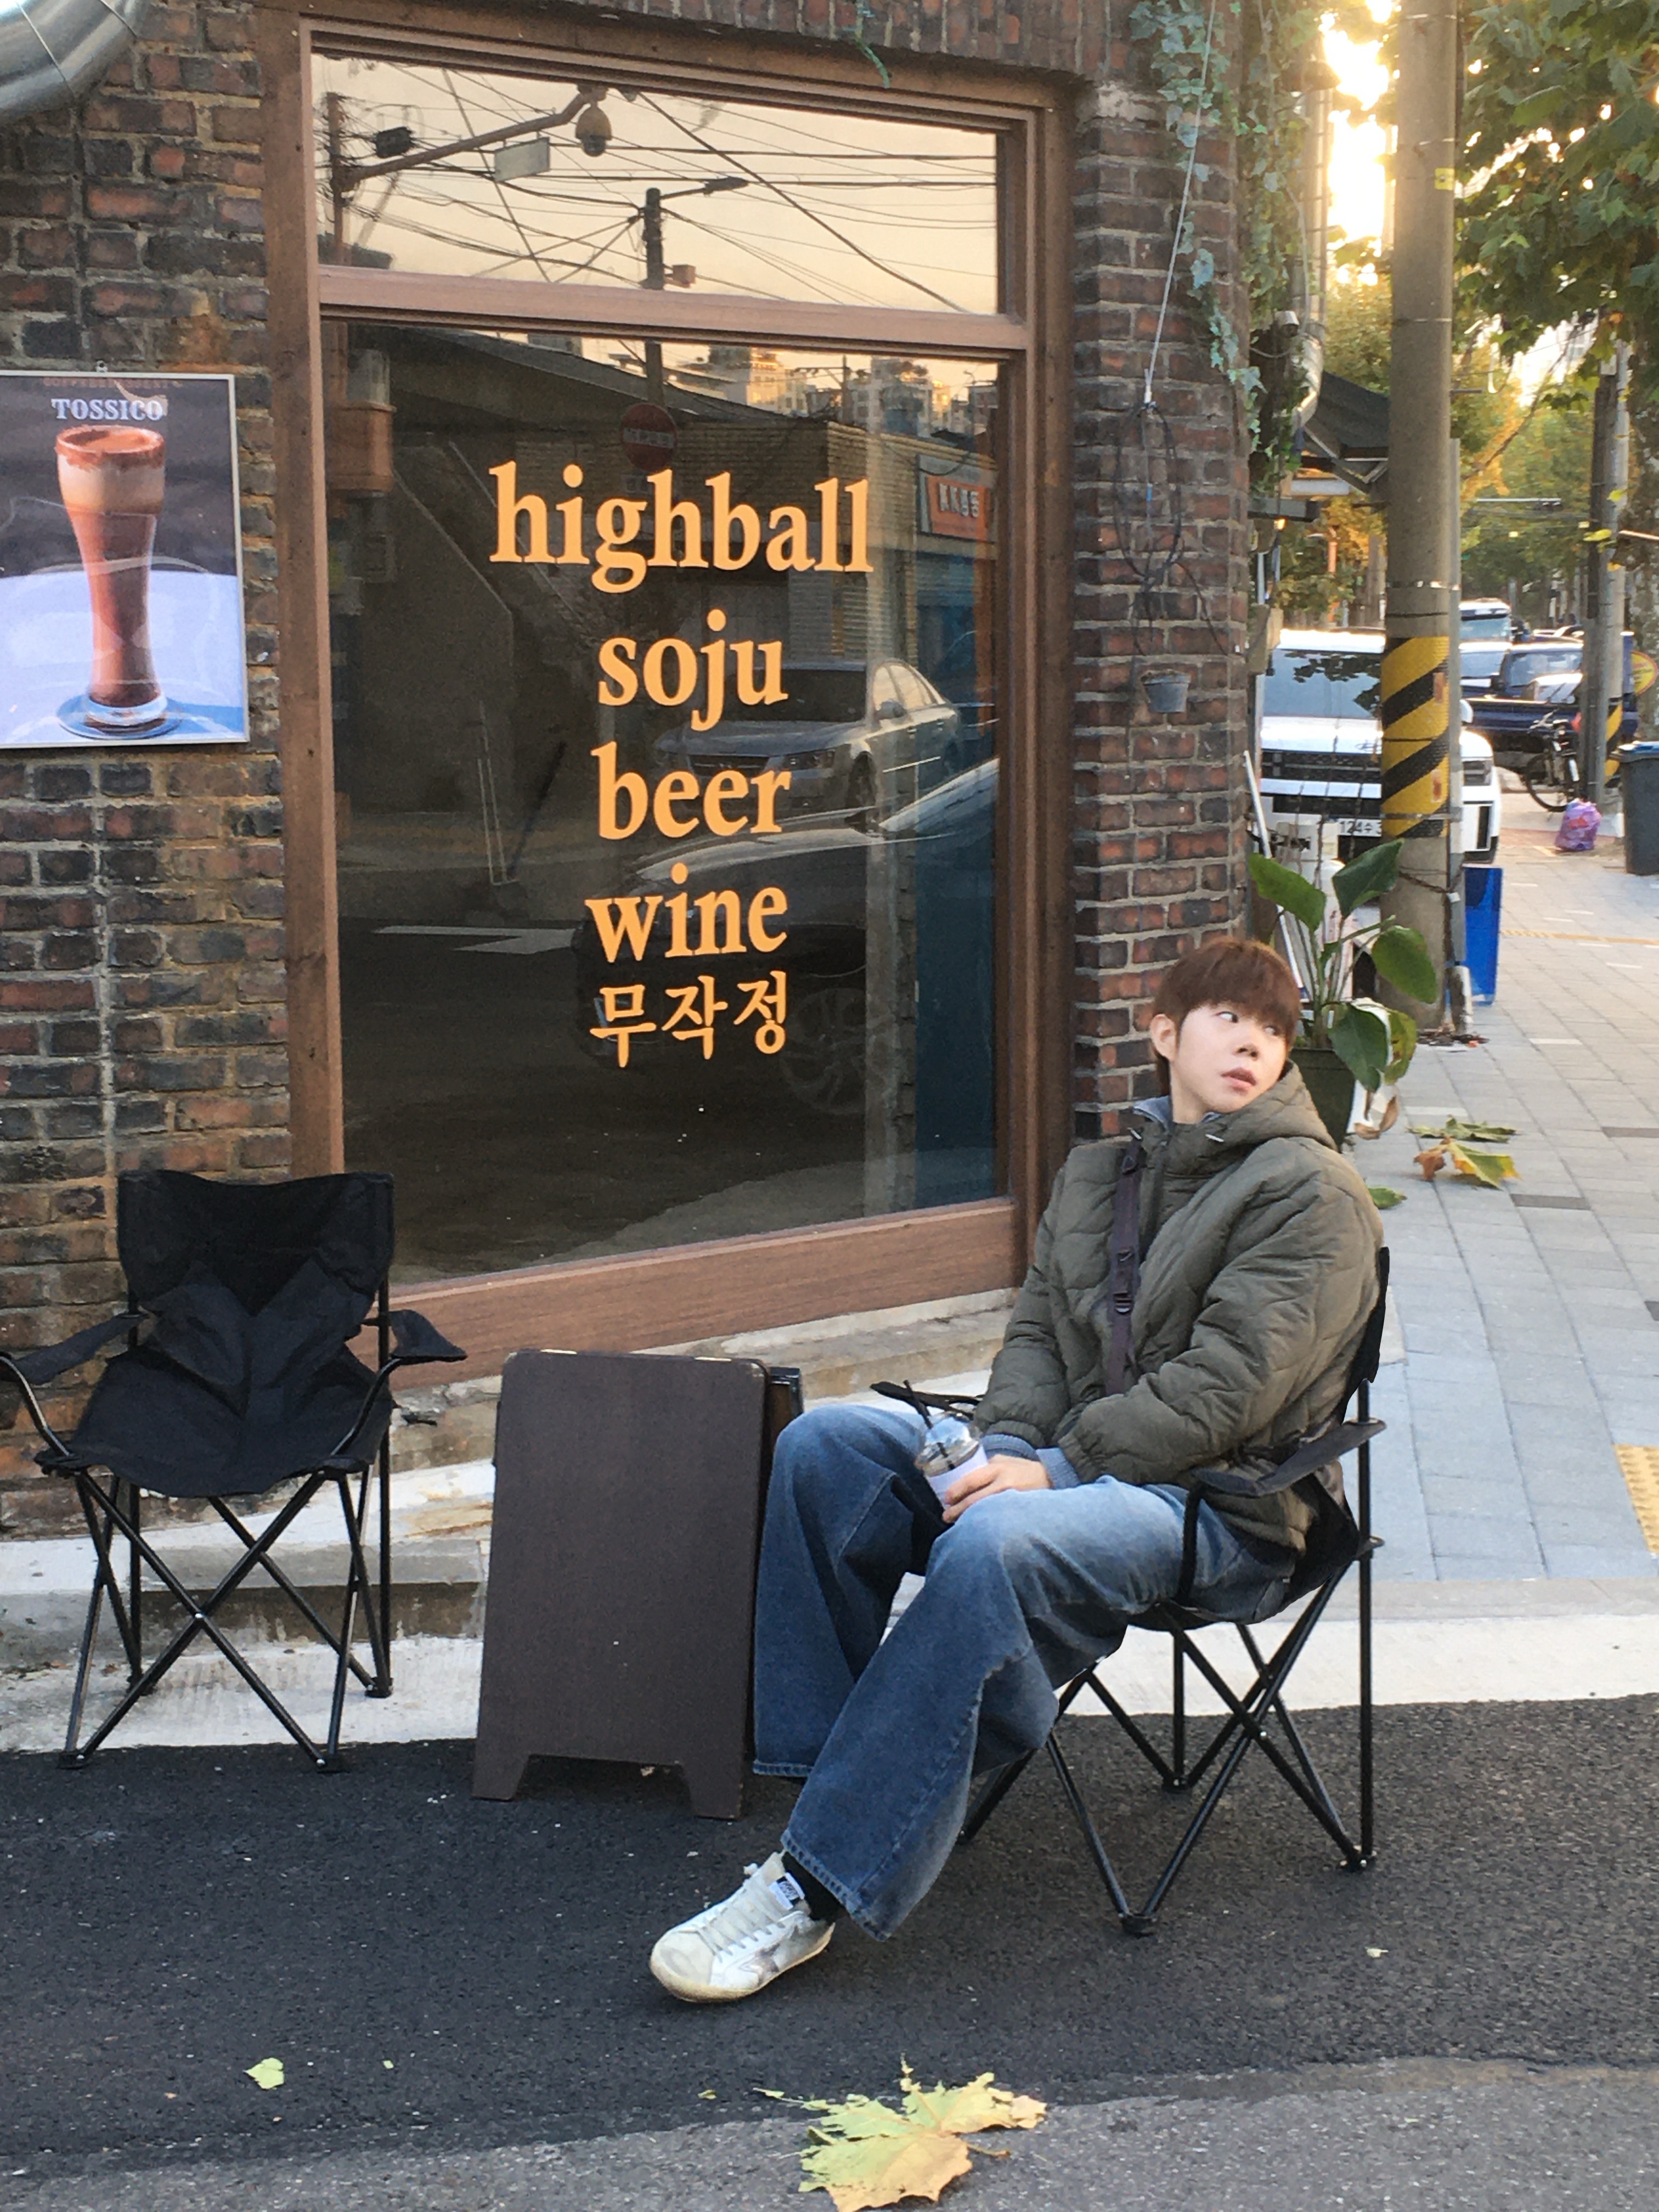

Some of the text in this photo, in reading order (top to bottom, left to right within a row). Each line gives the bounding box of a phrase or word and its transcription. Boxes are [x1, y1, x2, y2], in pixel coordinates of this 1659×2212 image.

[51, 398, 163, 421] TOSSICO
[489, 461, 874, 593] highball
[599, 609, 788, 731] soju
[591, 741, 792, 840] beer
[585, 862, 787, 963] wine
[590, 970, 787, 1068] 무작정
